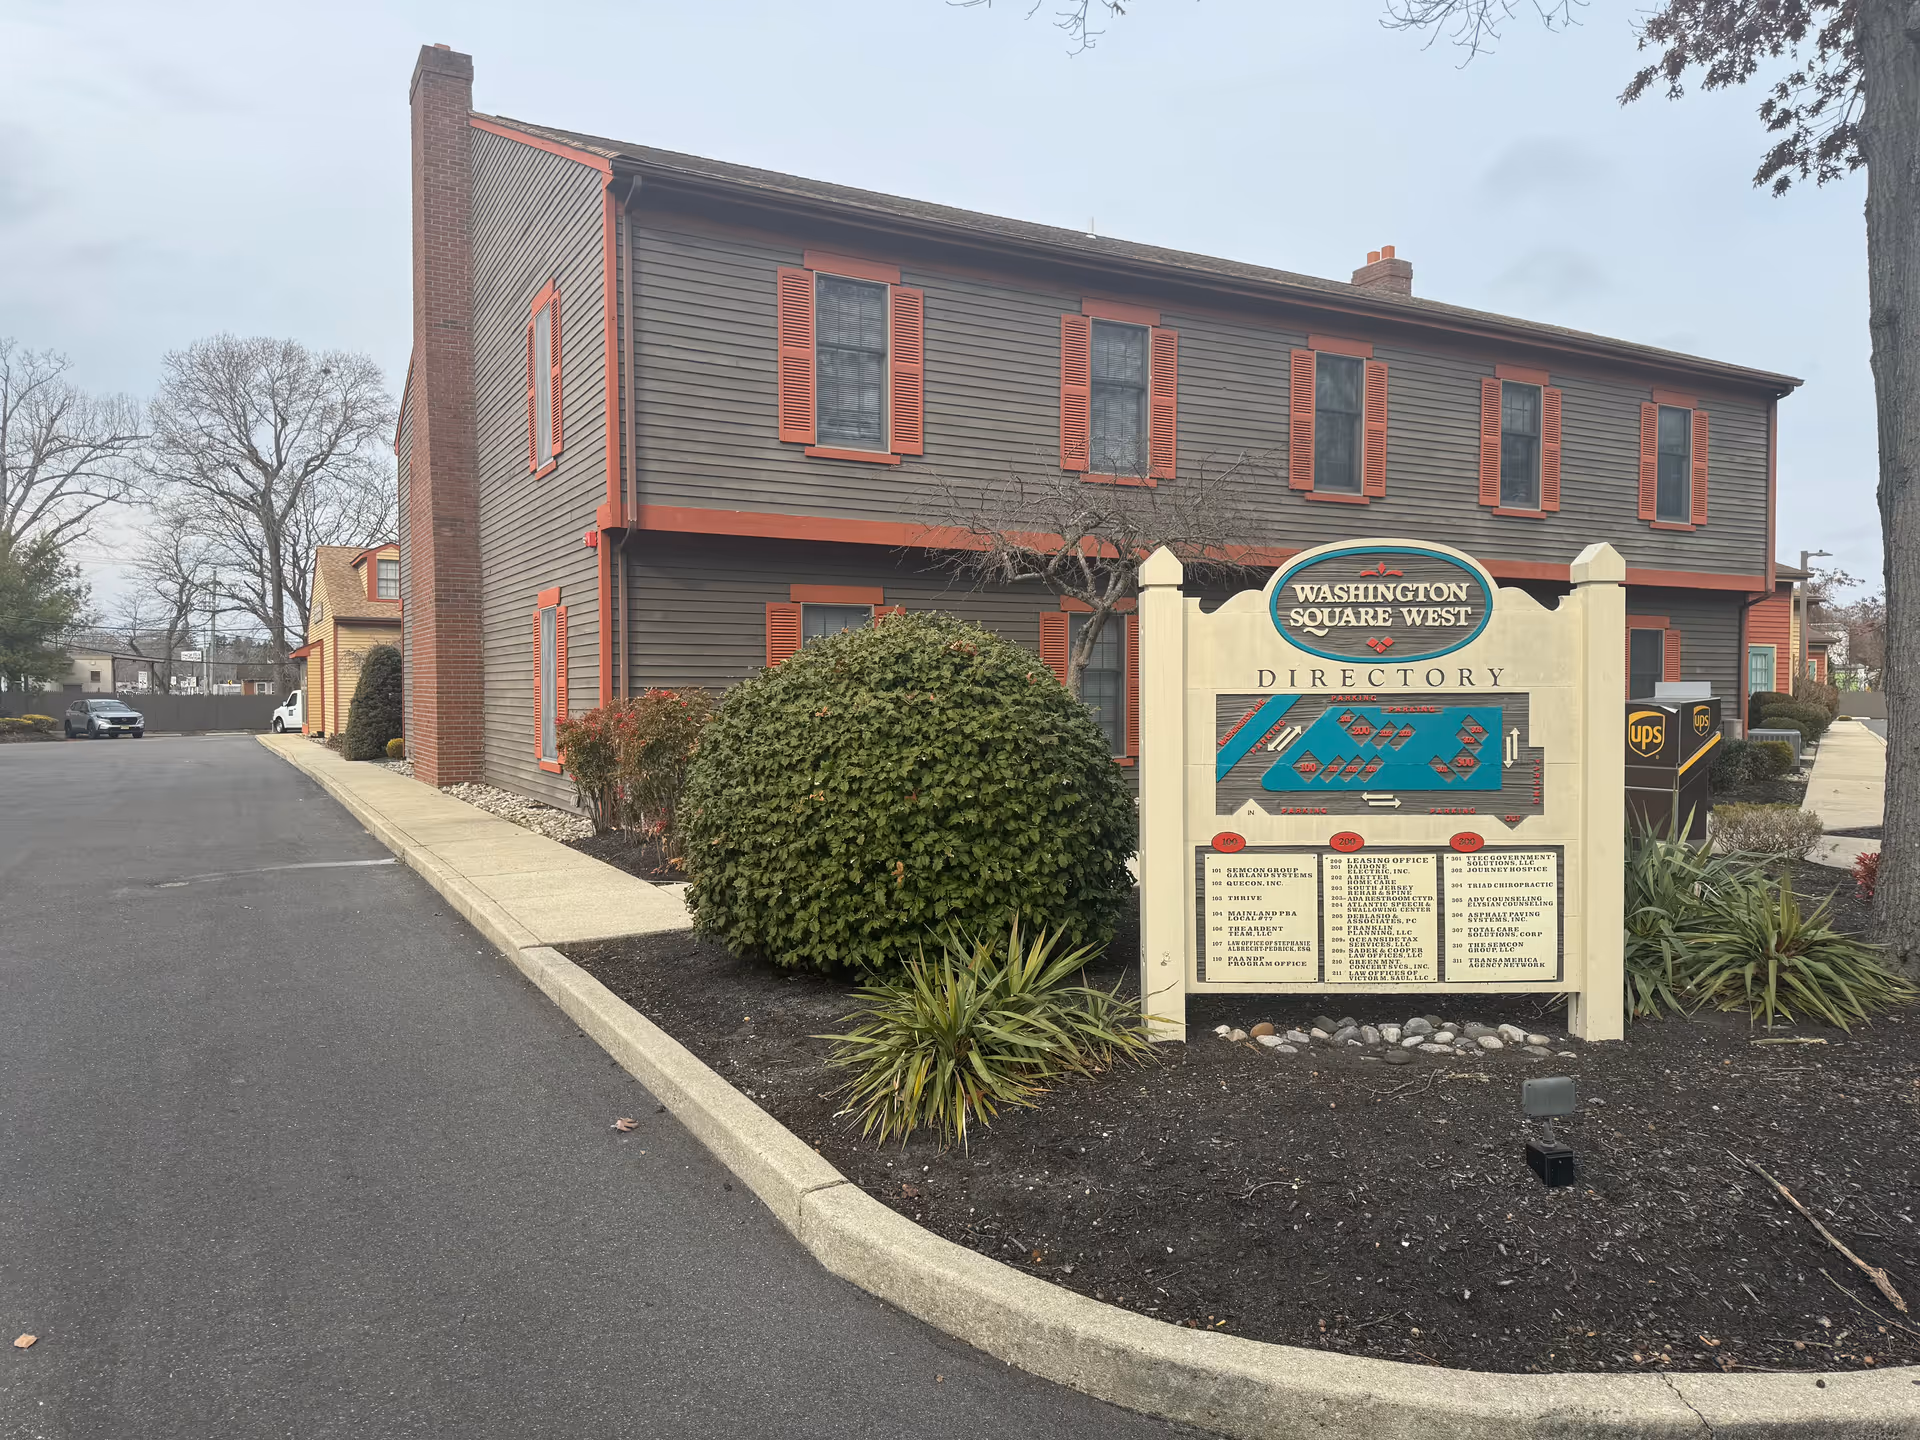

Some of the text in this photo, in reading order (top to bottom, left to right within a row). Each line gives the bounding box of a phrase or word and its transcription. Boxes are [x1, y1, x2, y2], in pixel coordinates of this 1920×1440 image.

[1292, 583, 1470, 603] WASHINGTON
[1289, 608, 1471, 637] SQUARE WEST
[1258, 668, 1504, 688] DIRECTORY
[1218, 699, 1266, 747] WASHINGTON AVE
[1352, 726, 1370, 735] 200
[1695, 715, 1709, 731] ups
[1250, 720, 1286, 755] PARKING
[1631, 726, 1662, 749] ups
[1300, 763, 1316, 772] 100
[1457, 758, 1474, 767] 300
[1222, 838, 1238, 846] 100
[1339, 838, 1356, 846] 200
